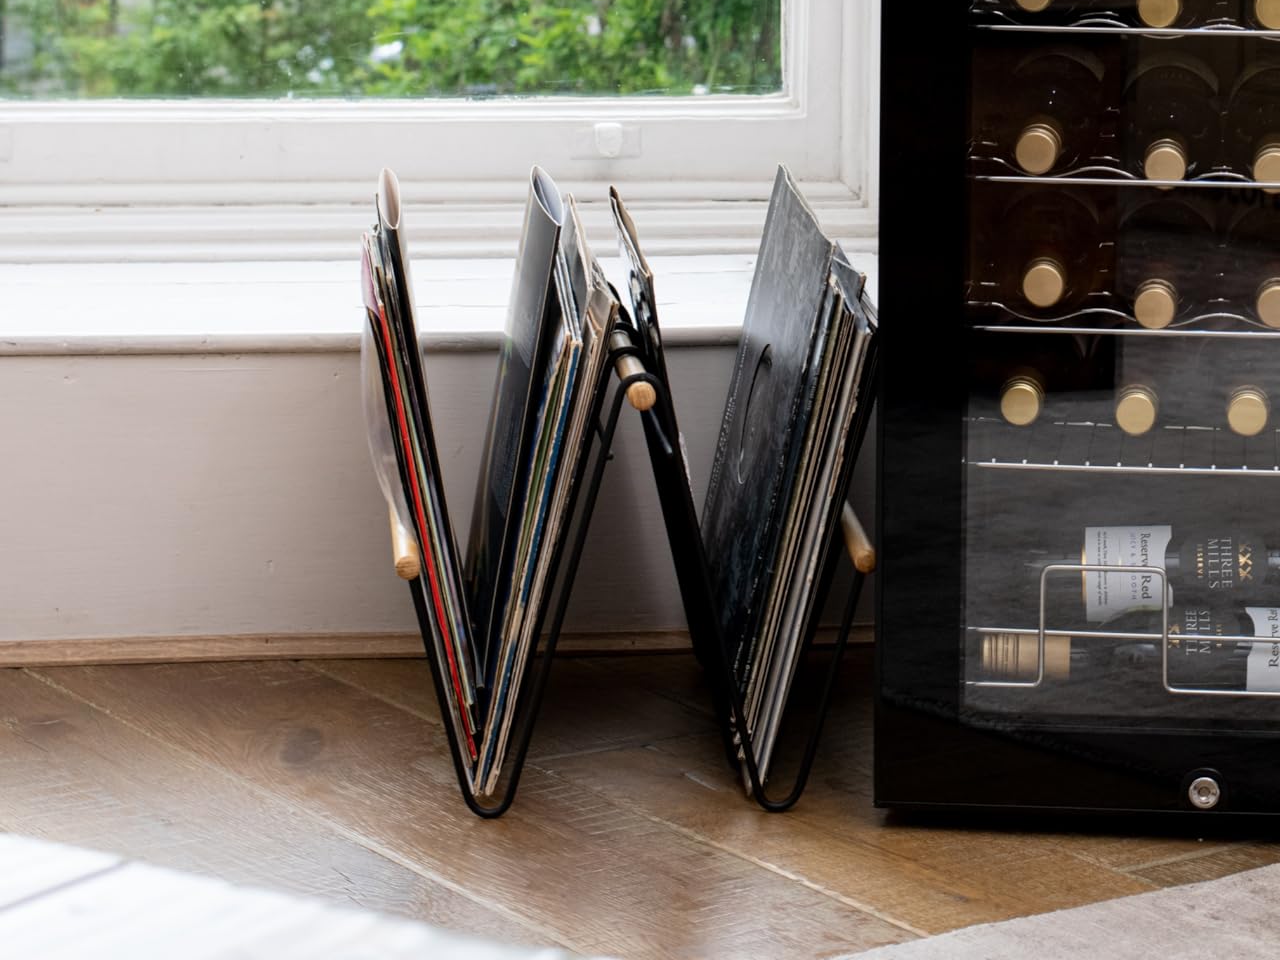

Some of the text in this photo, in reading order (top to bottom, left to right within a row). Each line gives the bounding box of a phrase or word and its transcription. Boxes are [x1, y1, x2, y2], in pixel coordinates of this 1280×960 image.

[1140, 532, 1153, 600] Reserv Red
[1207, 538, 1220, 589] MILLS
[1220, 537, 1233, 589] THREE
[1199, 610, 1211, 654] MLLS
